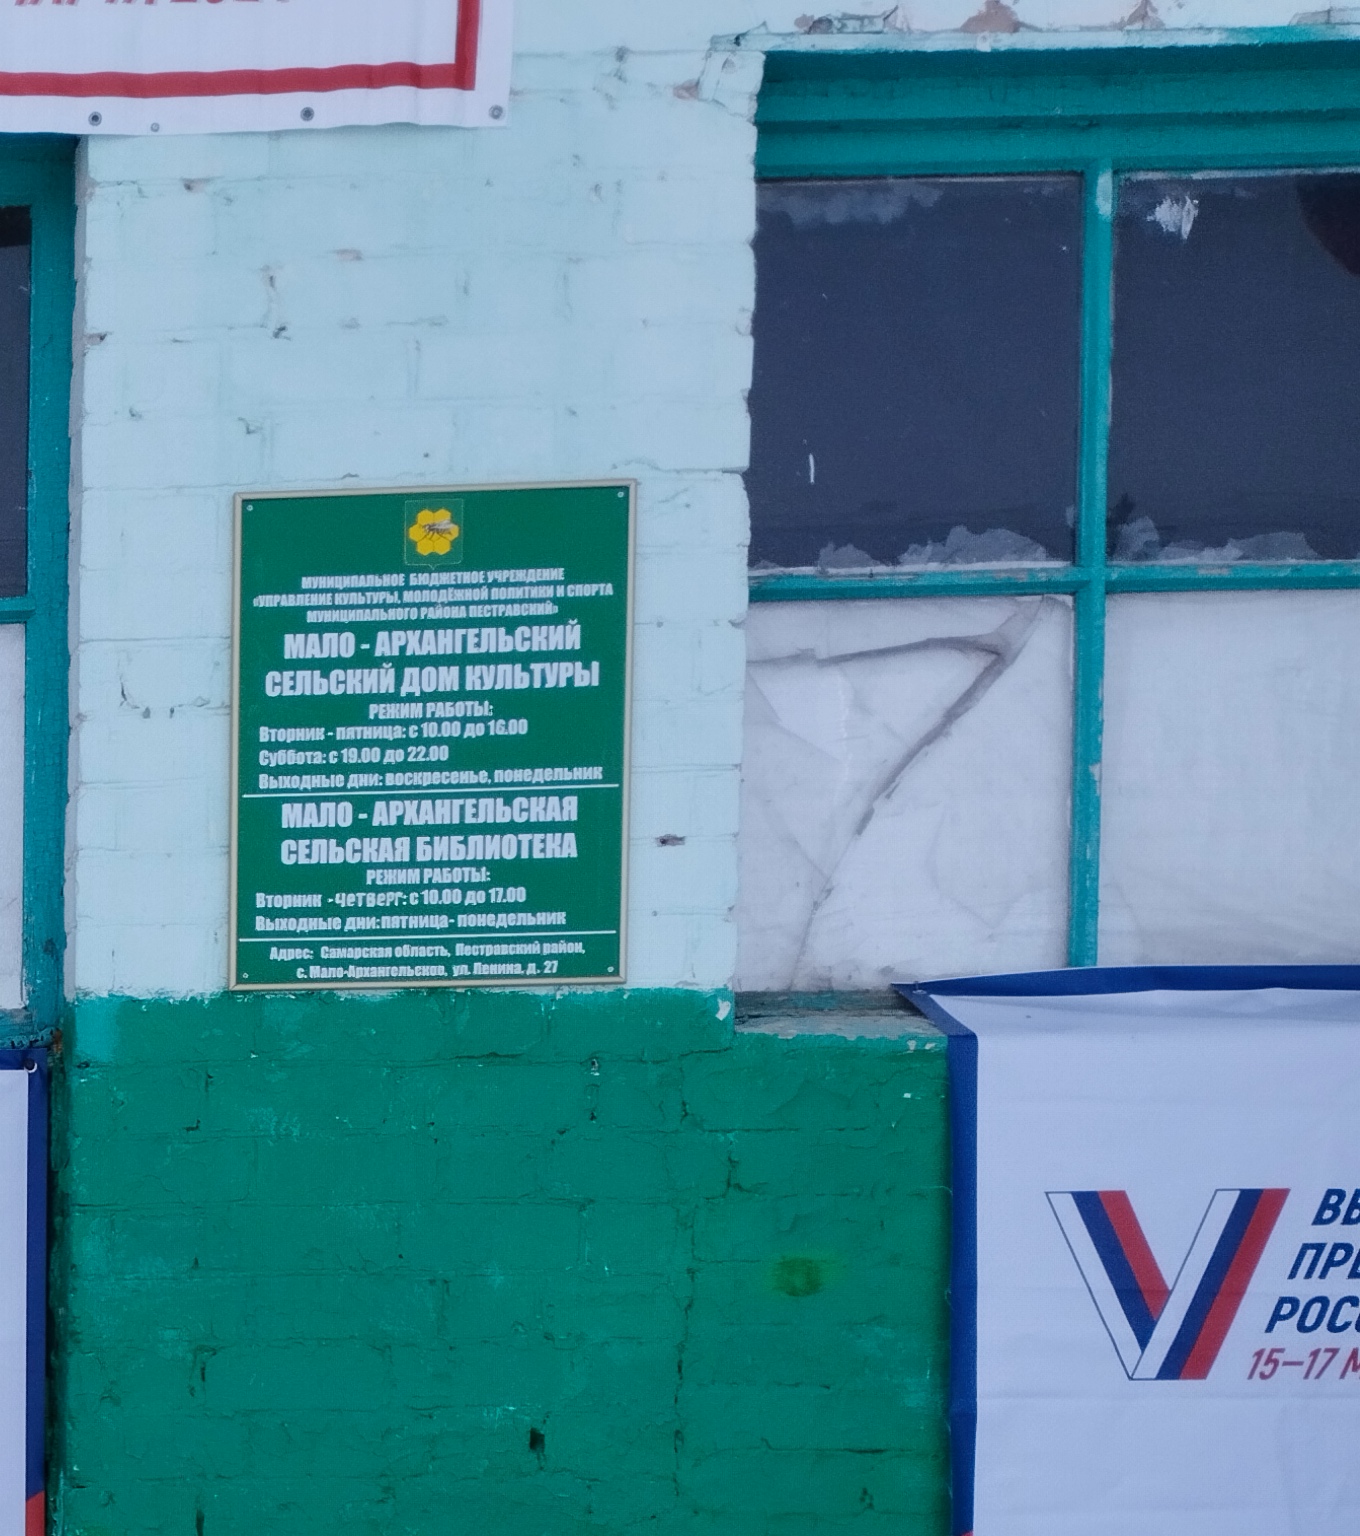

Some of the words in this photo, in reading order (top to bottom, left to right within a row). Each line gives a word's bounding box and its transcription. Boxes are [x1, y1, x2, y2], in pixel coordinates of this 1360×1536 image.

[302, 574, 405, 590] МУНИЦИПАЛЬНОЕ
[409, 571, 485, 586] БЮДЖЕТНОЕ
[487, 568, 565, 583] УЧРЕЖДЕНИЕ
[491, 585, 554, 599] ПОЛИТИКИ
[556, 585, 564, 597] И
[567, 583, 613, 597] СПОРТА
[307, 608, 418, 623] МУНИЦИПАЛЬНОГО
[420, 604, 467, 619] РАЙОНА
[284, 632, 355, 659] МАЛО
[375, 618, 581, 656] АРХАНГЕЛЬСКИЙ
[265, 662, 395, 696] СЕЛЬСКИЙ
[401, 667, 459, 696] ДОМ
[466, 661, 600, 692] КУЛЬТУРЫ
[369, 703, 423, 719] РЕЖИМ
[426, 701, 493, 718] РАБОТЫ:
[259, 726, 325, 743] Вторник
[336, 725, 406, 741] пятница:
[408, 725, 418, 738] с
[421, 721, 461, 738] 10.00
[463, 723, 485, 738] до
[488, 719, 528, 735] 16.00
[259, 750, 326, 767] Суббота:
[329, 751, 338, 763] с
[341, 748, 380, 763] 19.00
[383, 749, 404, 764] до
[407, 745, 449, 762] 22.00
[259, 774, 344, 790] Выходные
[347, 773, 383, 789] дни:
[385, 769, 492, 786] воскресенье,
[494, 767, 603, 783] понедельник
[282, 802, 352, 828] МАЛО
[372, 796, 578, 826] АРХАНГЕЛЬСКАЯ
[281, 837, 410, 865] СЕЛЬСКАЯ
[417, 833, 578, 862] БИБЛИОТЕКА
[366, 868, 420, 885] РЕЖИМ
[423, 867, 491, 884] РАБОТЫ:
[256, 892, 322, 909] Вторник
[410, 892, 419, 905] с
[422, 889, 462, 904] 10.00
[465, 890, 486, 906] до
[489, 887, 526, 903] 17.00
[255, 916, 341, 932] Выходные
[458, 912, 566, 928] понедельник
[270, 947, 313, 961] Адрес:
[321, 946, 392, 959] Самарская
[456, 941, 540, 956] Пестравский
[544, 961, 558, 973] 27
[1248, 1348, 1340, 1380] 15–17
